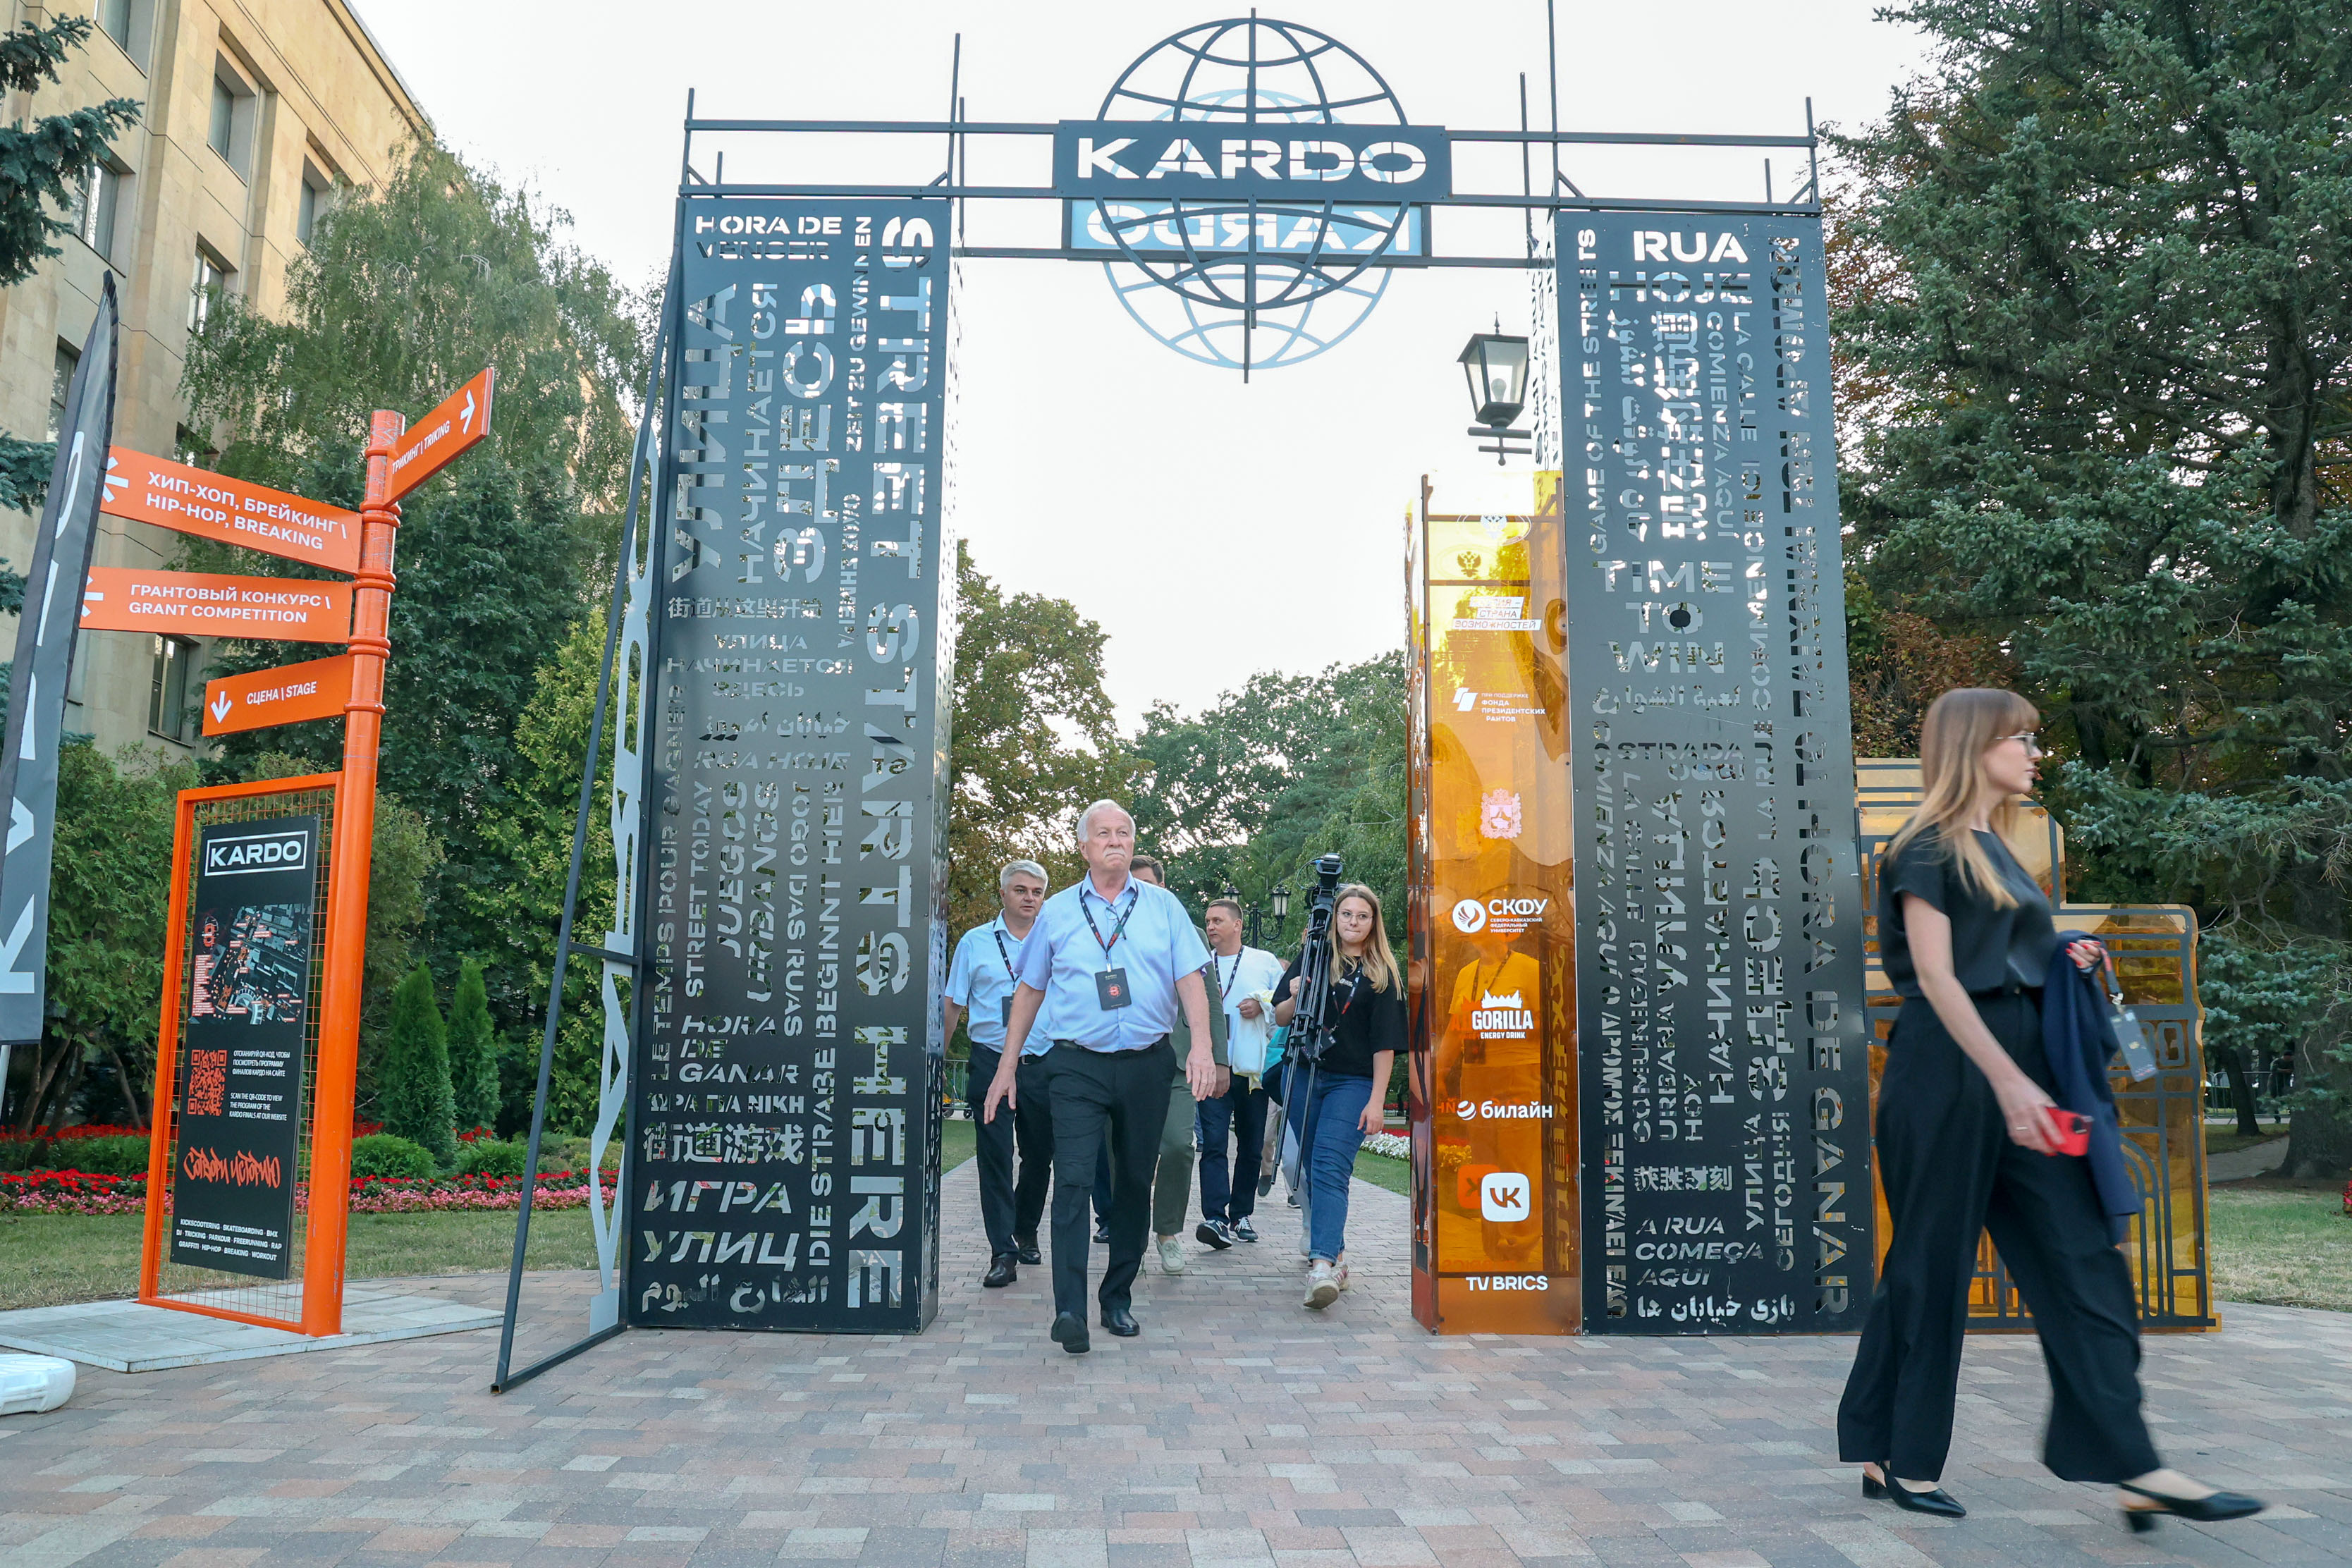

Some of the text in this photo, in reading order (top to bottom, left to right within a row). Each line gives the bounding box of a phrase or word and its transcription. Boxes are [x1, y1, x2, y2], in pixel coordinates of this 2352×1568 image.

[1078, 137, 1426, 183] KARDO
[695, 216, 842, 235] HORA DE
[1634, 231, 1748, 264] RUA
[1583, 361, 1602, 417] THE
[392, 420, 451, 474] ТРИКИНГ TRIKING
[672, 283, 742, 583] УЛИЦА
[773, 283, 840, 584] ЗДЕСЬ
[1586, 423, 1604, 461] OF
[147, 472, 338, 531] ХИП-ХОП, БРЕЙКИНГ
[1587, 468, 1608, 554] GAME
[146, 492, 323, 550] HIP-HOP, BREAKING
[1593, 561, 1734, 593] TIME
[130, 584, 321, 607] ГРАНТОВЫЙ КОНКУРС
[129, 601, 307, 623] GRANT COMPETITION
[1625, 601, 1703, 635] TO
[714, 634, 807, 652] УЛИЦА
[1608, 641, 1725, 673] WIN
[666, 658, 852, 674] НАЧИНАЕТСЯ
[247, 681, 317, 705] СЦЕНА STAGE
[693, 751, 851, 770] RUA HOJE
[847, 216, 933, 1309] STREET STARTS HERE
[210, 840, 301, 867] KARDO
[716, 780, 747, 958] JUEGOS
[685, 781, 712, 998] STREET TODAY
[747, 780, 778, 1003] URBANOS
[1652, 788, 1691, 997] УЛИЦА
[1488, 899, 1548, 915] СКФУ
[815, 874, 841, 1038] BEGINNT
[784, 948, 805, 1037] RUAS
[681, 1015, 776, 1036] HORA
[1471, 1010, 1533, 1030] GORILLA
[680, 1039, 728, 1058] DE
[678, 1063, 800, 1084] GANAR
[1481, 1101, 1552, 1119] билайн
[643, 1180, 792, 1214] ИГРА
[1490, 1188, 1521, 1208] VK
[180, 1219, 220, 1230] KICKSCOOTERING
[223, 1224, 264, 1235] SKATEBOARDING
[185, 1230, 206, 1239] TRICKING
[209, 1234, 231, 1243] PARKOUR
[233, 1237, 268, 1248] FREERUNNING
[809, 1205, 832, 1266] DIE
[1664, 1217, 1725, 1235] RUA
[178, 1241, 200, 1249] GRAFFITI
[224, 1247, 248, 1256] BREAKING
[252, 1251, 277, 1261] WORKOUT
[642, 1230, 800, 1272] УЛИЦ
[1466, 1275, 1548, 1291] TV BRICS
